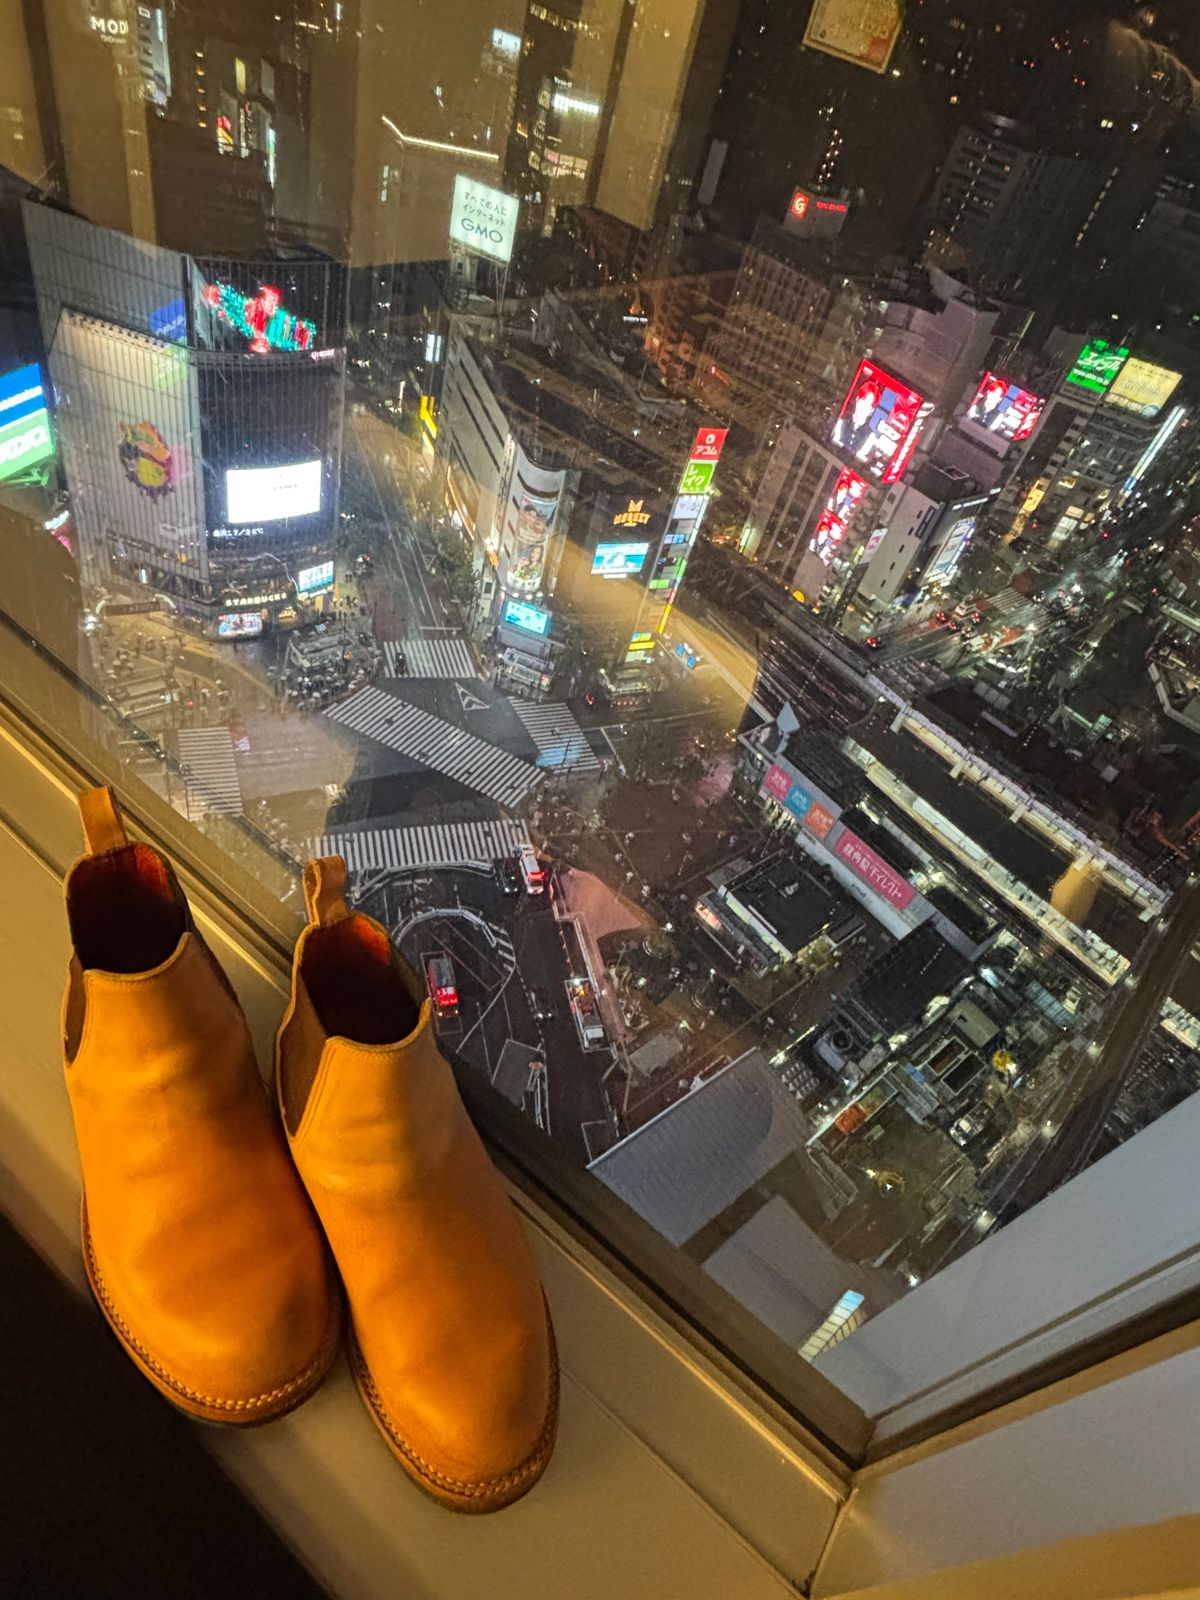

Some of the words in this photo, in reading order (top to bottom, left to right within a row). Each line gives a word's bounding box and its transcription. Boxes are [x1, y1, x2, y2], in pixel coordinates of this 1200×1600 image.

[460, 217, 504, 244] GMO
[694, 445, 718, 456] アコム
[225, 592, 288, 607] STARBUCKS
